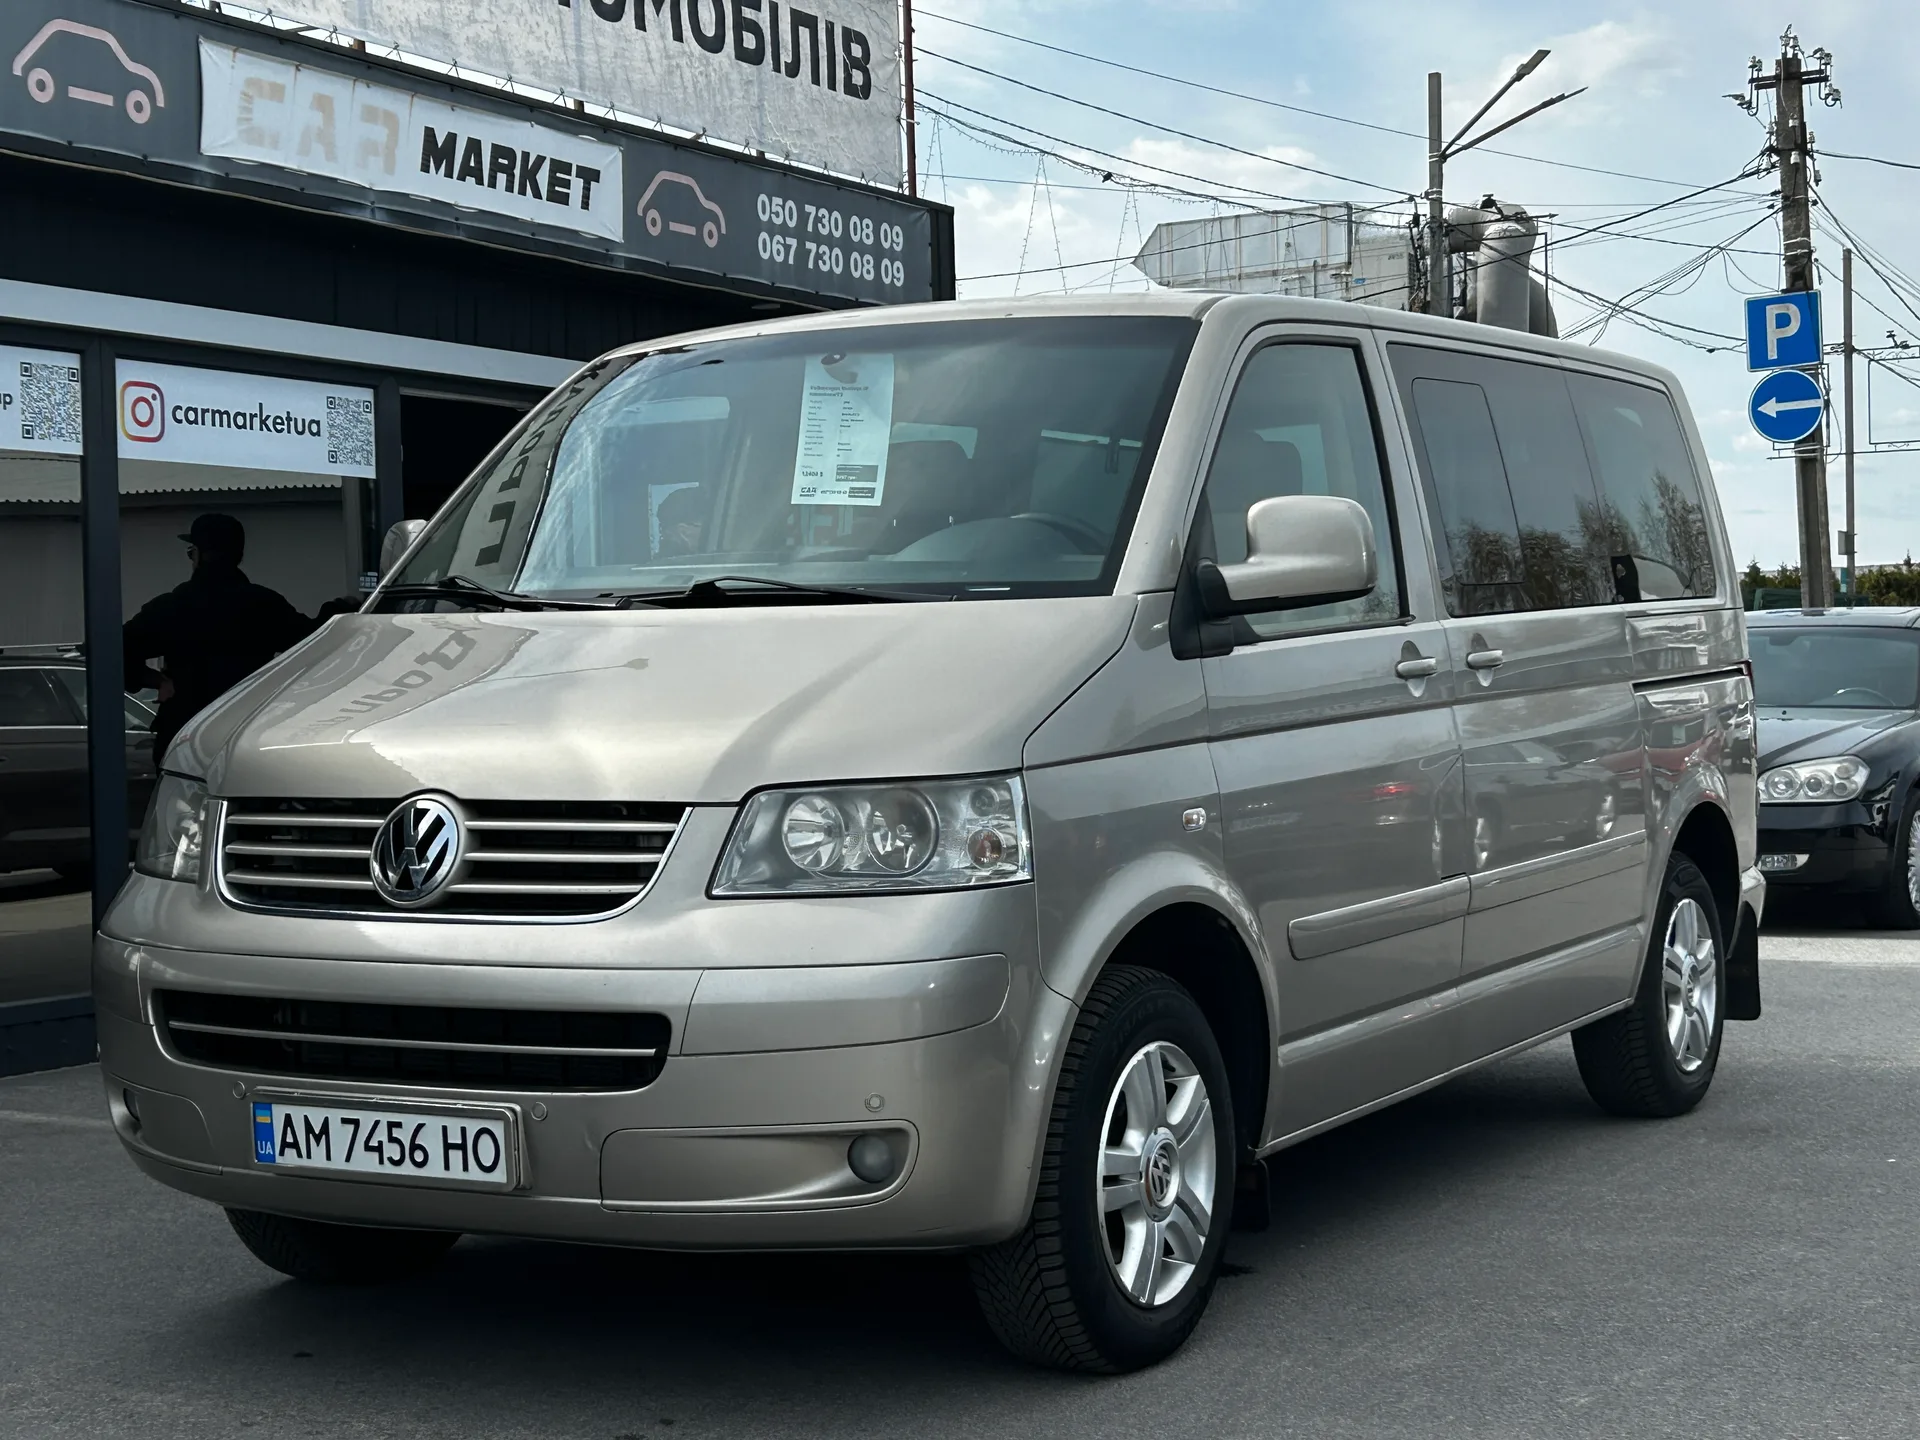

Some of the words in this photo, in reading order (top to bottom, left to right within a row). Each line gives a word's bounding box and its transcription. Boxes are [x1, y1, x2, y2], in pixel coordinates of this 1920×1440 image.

[419, 125, 601, 212] MARKET
[757, 193, 798, 228] 050
[804, 203, 842, 238] 730
[849, 215, 874, 245] 08
[880, 222, 904, 251] 09
[758, 231, 798, 265] 067
[805, 241, 843, 274] 730
[850, 251, 875, 281] 08
[881, 258, 904, 287] 09
[1765, 302, 1801, 361] P
[171, 402, 322, 438] carmarketua
[258, 1140, 273, 1155] UA
[278, 1112, 332, 1162] AM
[340, 1116, 429, 1169] 7456
[441, 1124, 501, 1173] HO
